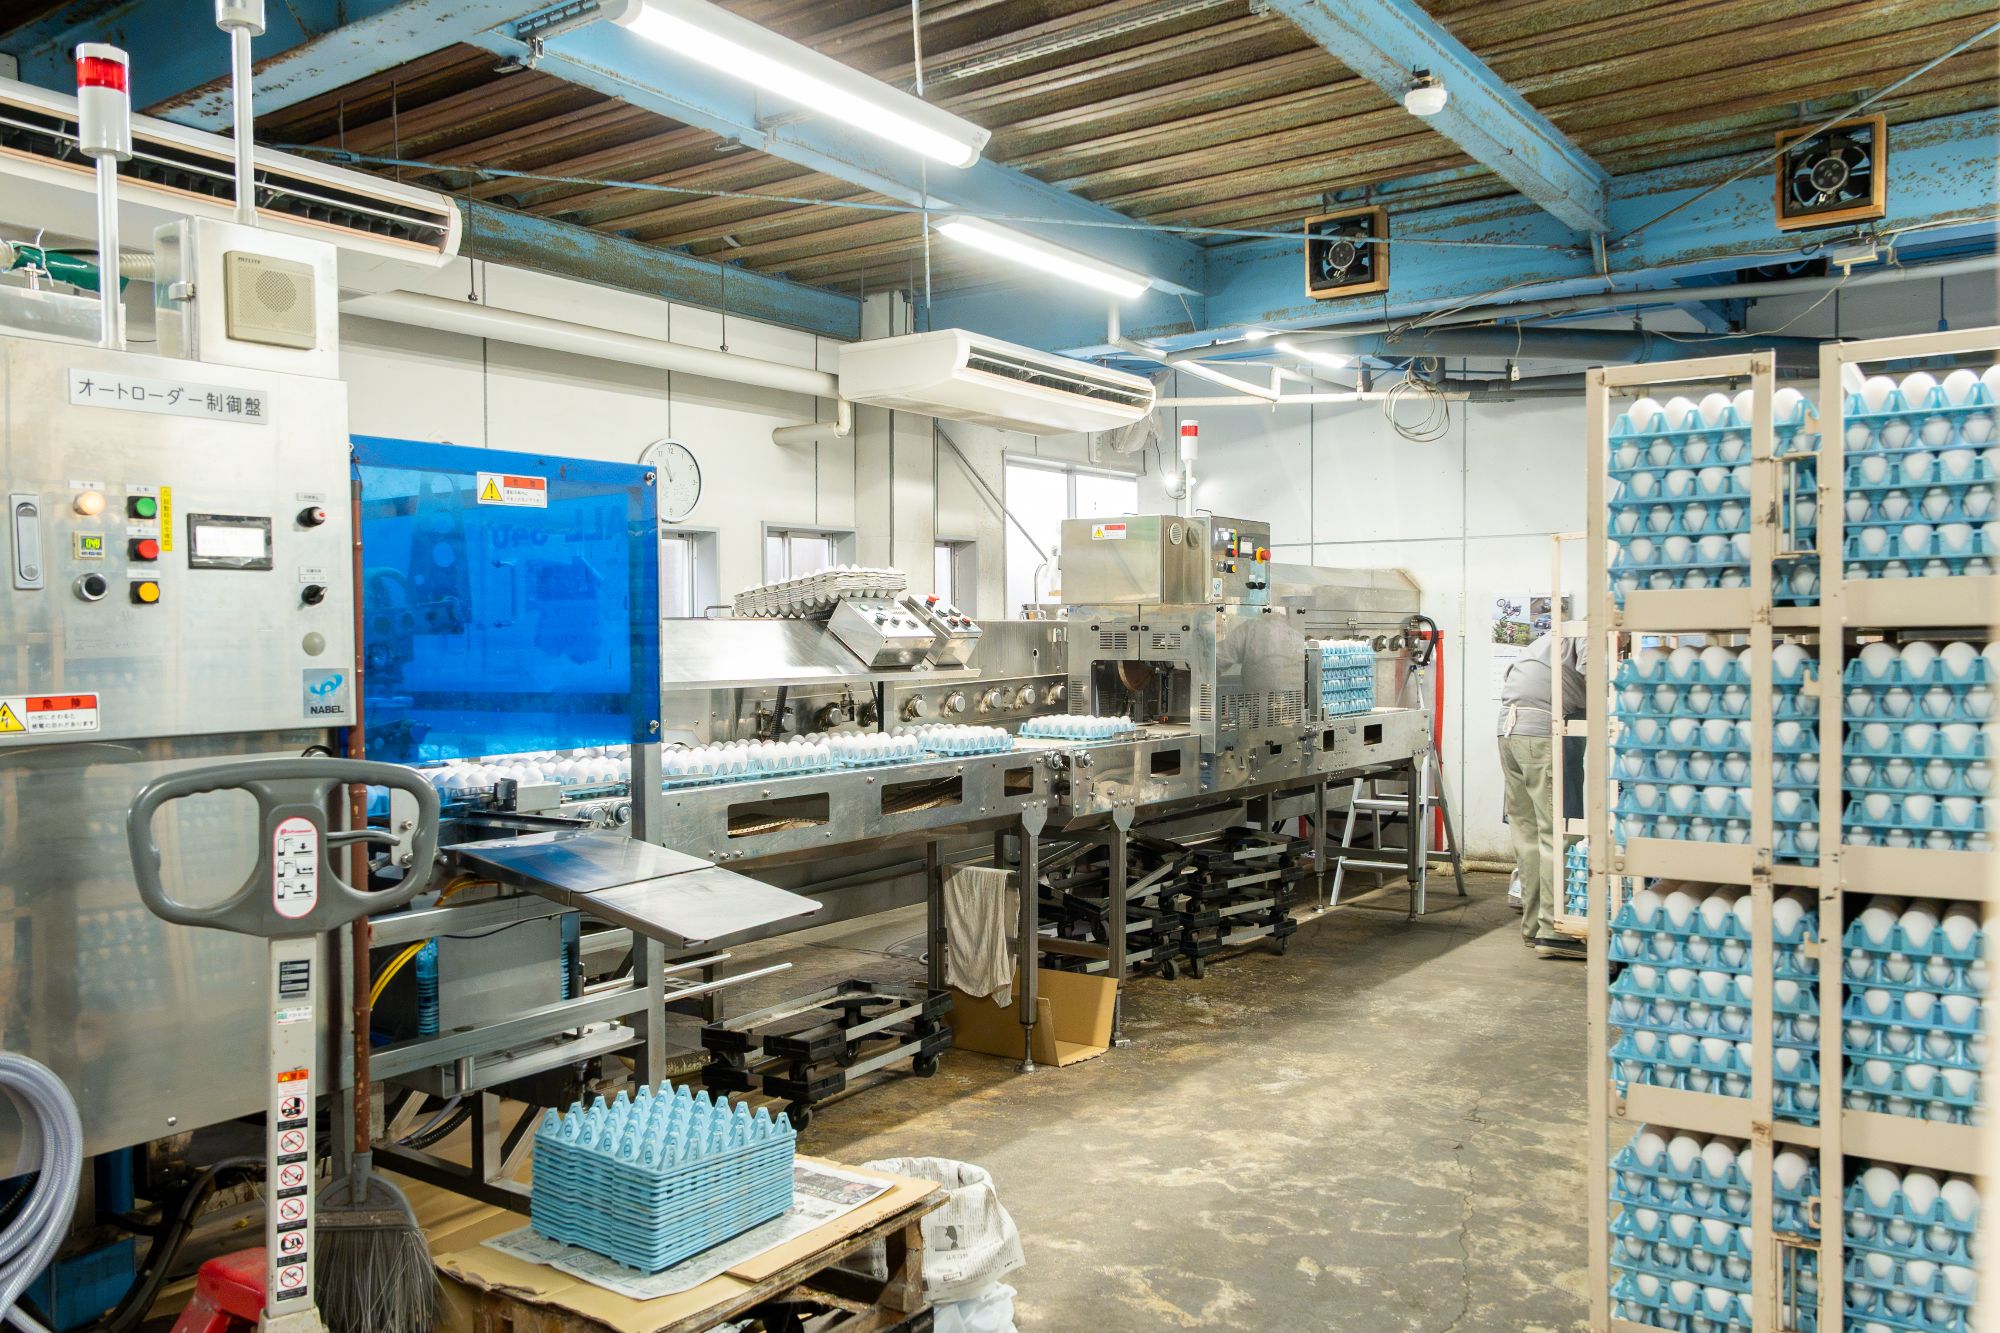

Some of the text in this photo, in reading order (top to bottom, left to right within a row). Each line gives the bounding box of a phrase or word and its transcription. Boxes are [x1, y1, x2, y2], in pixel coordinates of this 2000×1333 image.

[78, 378, 262, 417] オートローダー制御盤
[667, 447, 674, 455] 12
[310, 705, 344, 714] NABEL
